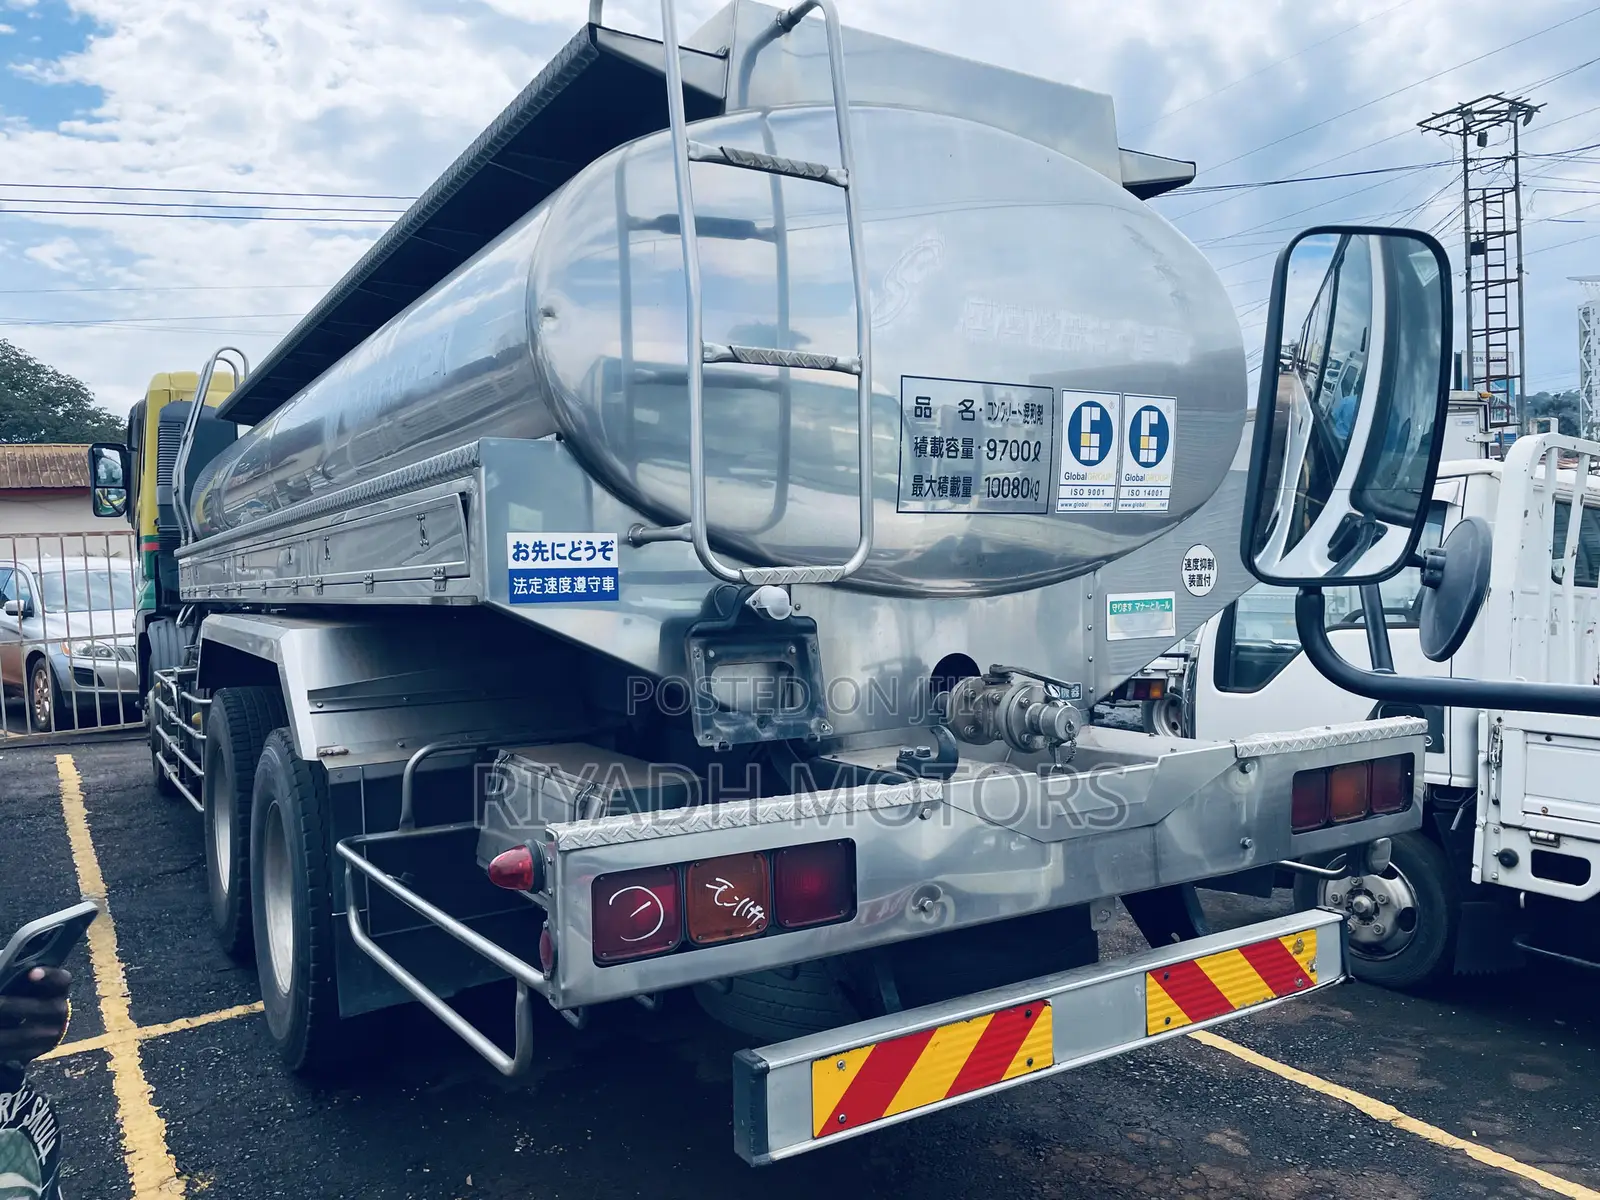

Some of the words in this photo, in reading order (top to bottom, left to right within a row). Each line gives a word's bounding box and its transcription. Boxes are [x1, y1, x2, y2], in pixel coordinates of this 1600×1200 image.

[914, 396, 932, 418] 品
[911, 474, 973, 498] 最大積載量
[1070, 488, 1085, 496] ISO
[1087, 488, 1105, 496] 9001
[512, 540, 615, 562] お先にどうぞ
[1184, 557, 1215, 571] 速度抑制
[513, 576, 615, 595] 法定速度遵守車
[1188, 574, 1211, 587] 装置付
